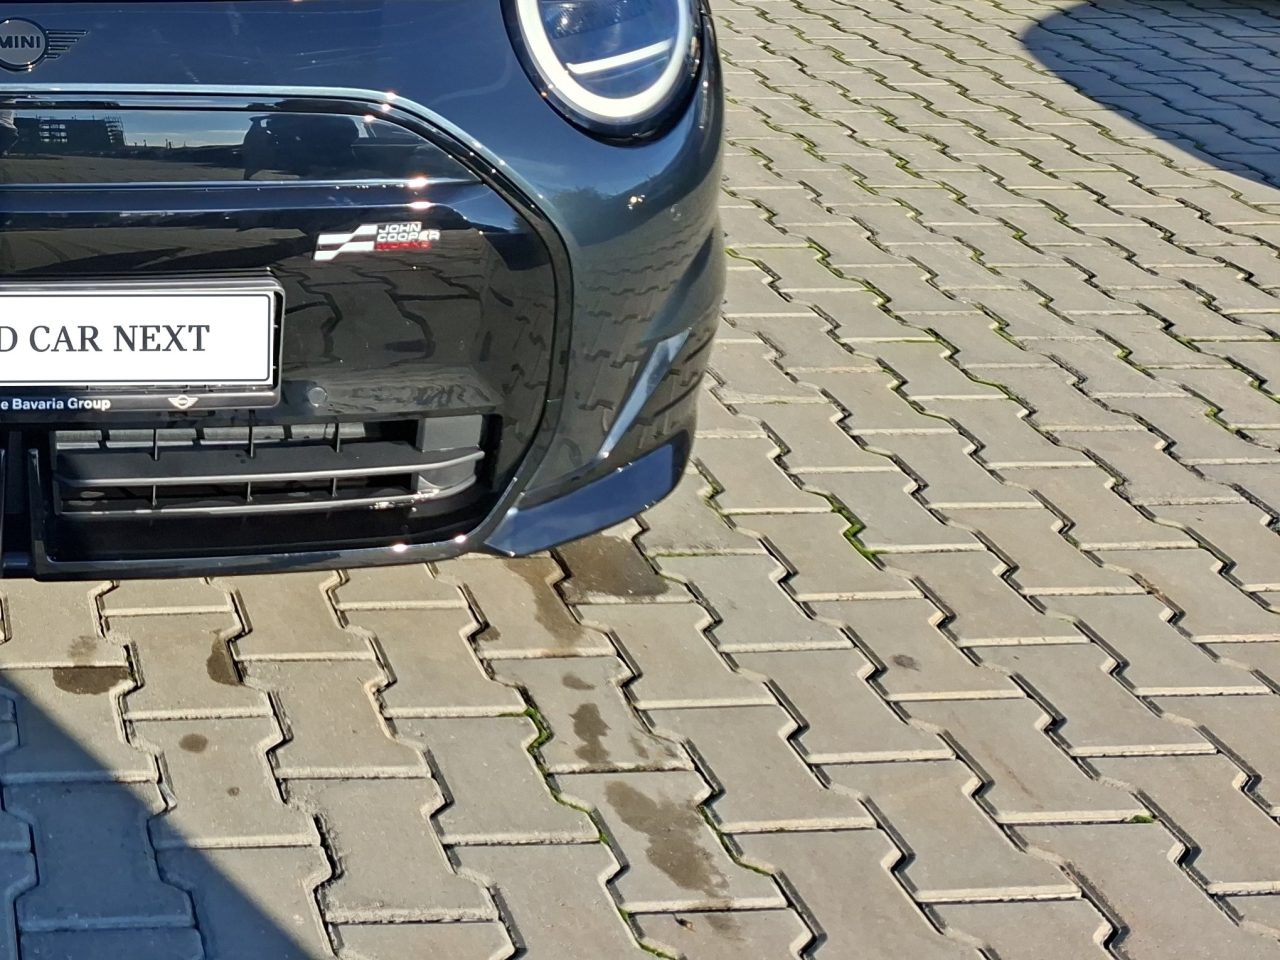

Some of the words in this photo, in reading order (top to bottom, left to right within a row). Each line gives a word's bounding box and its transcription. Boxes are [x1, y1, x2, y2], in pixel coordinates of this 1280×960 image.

[378, 222, 422, 233] JOHN
[29, 325, 103, 353] CAR
[113, 324, 210, 352] NEXT
[12, 398, 65, 410] Bavaria
[67, 398, 112, 412] Group
